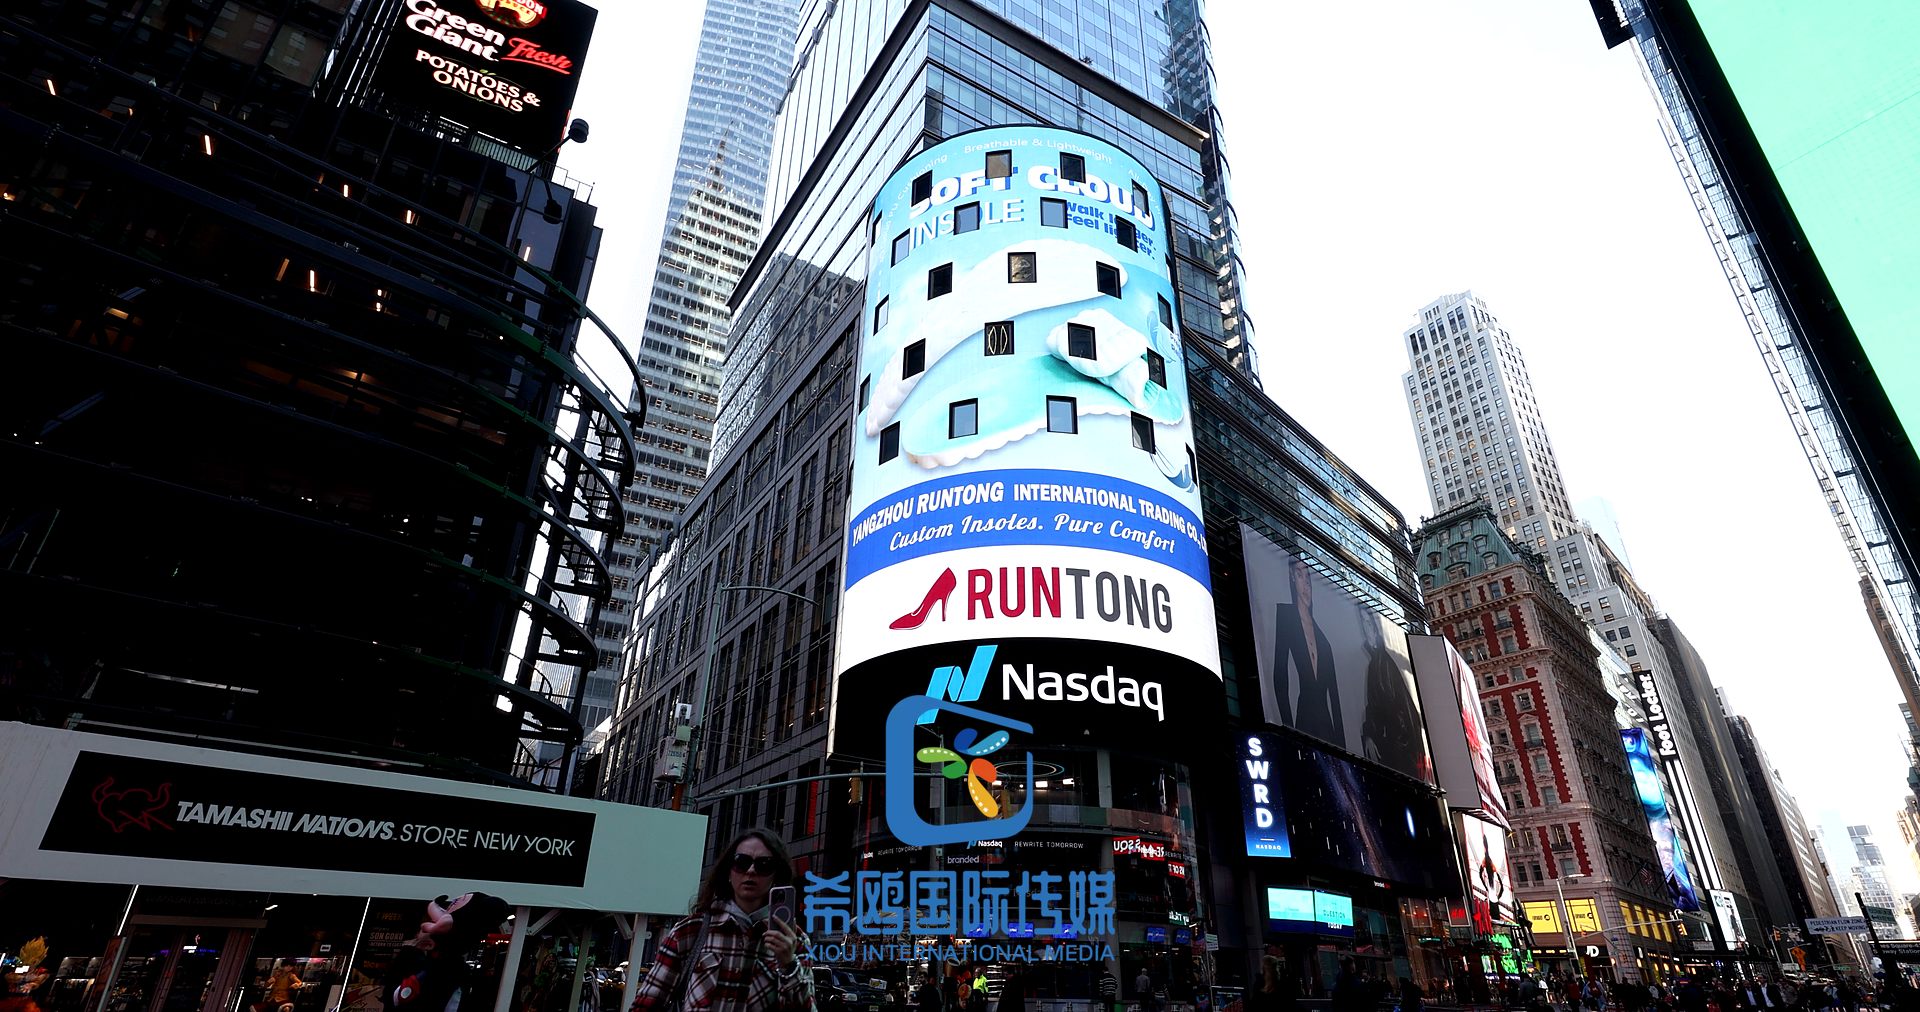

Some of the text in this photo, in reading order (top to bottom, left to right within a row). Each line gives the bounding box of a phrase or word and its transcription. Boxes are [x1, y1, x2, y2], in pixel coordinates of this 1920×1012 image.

[406, 13, 573, 71] Giant Fresh
[407, 0, 506, 47] Green
[415, 49, 541, 107] POTATOES &
[433, 70, 523, 112] ONIONS
[964, 137, 1028, 154] Breathable
[1032, 137, 1044, 147] &
[1047, 138, 1113, 165] Lightweight
[909, 198, 1025, 250] INSLE
[852, 496, 914, 547] YANGZHOU
[916, 481, 1004, 513] RUNTONG
[1013, 483, 1137, 514] INTERNATIONAL
[1138, 498, 1186, 534] TRADING
[889, 520, 953, 552] Custom
[961, 512, 1044, 535] Insoles.
[1054, 513, 1103, 534] Pure
[1109, 520, 1176, 554] Comfort
[967, 566, 1173, 633] RUNTONG
[1002, 663, 1165, 722] Nasdaq
[1653, 723, 1677, 756] Foot
[1246, 737, 1273, 829] SWRD
[176, 801, 576, 857] TAMASHII NATIONS STORE NEW YORK
[977, 840, 1003, 848] Nasdaq
[1046, 841, 1084, 849] TOMORROW
[946, 855, 980, 864] branded
